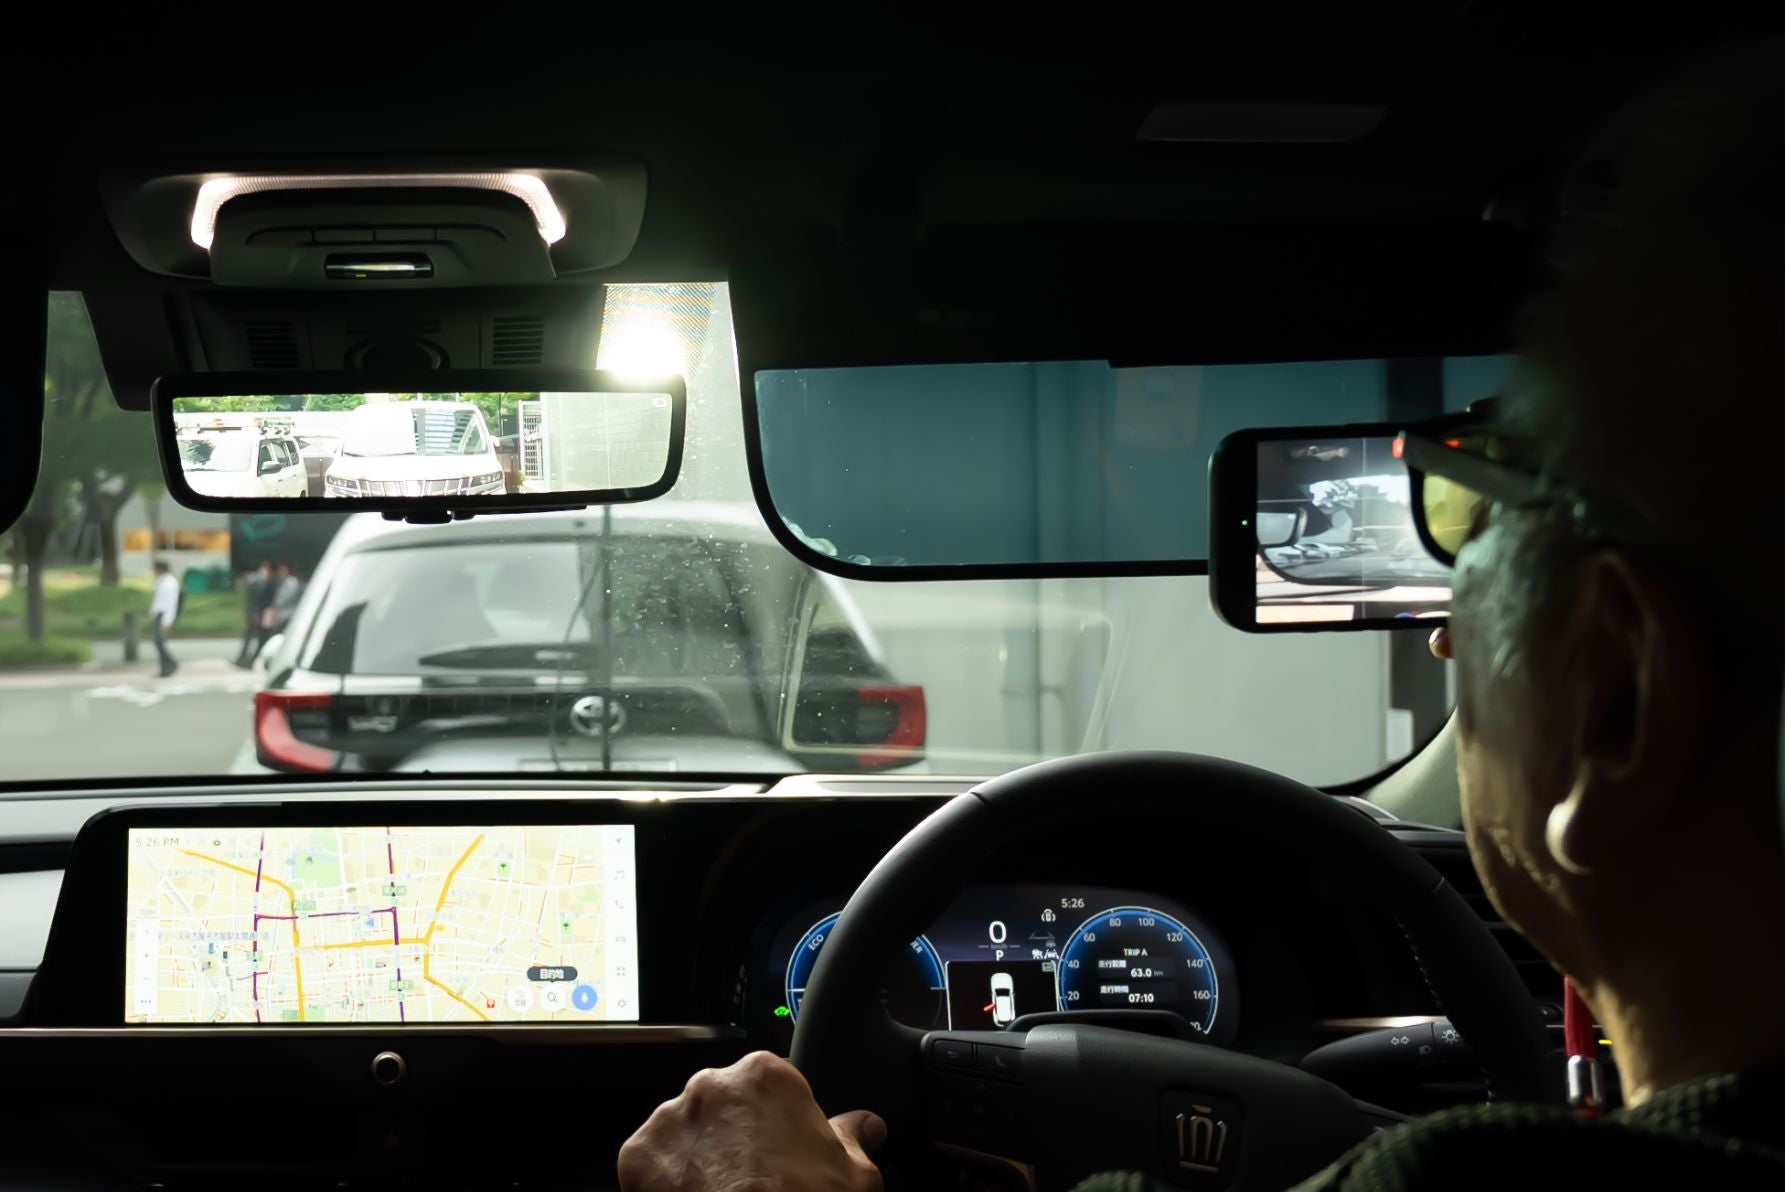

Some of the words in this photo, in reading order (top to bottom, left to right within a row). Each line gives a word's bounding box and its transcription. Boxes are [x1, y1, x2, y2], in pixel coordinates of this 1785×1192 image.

[163, 837, 180, 847] PM
[1061, 898, 1085, 909] 5:26
[1109, 917, 1122, 928] 80
[1138, 917, 1155, 927] 100
[988, 920, 1007, 944] 0
[1166, 932, 1183, 942] 120
[808, 934, 824, 951] ECO
[1083, 932, 1096, 943] 60
[995, 949, 1005, 961] P
[1123, 948, 1140, 957] TRIP
[1141, 948, 1148, 957] A
[1067, 959, 1080, 969] 40
[1186, 959, 1204, 969] 140
[1130, 968, 1152, 978] 63.0
[1067, 990, 1080, 1001] 20
[1128, 993, 1154, 1003] 07:10
[1193, 990, 1211, 1000] 160
